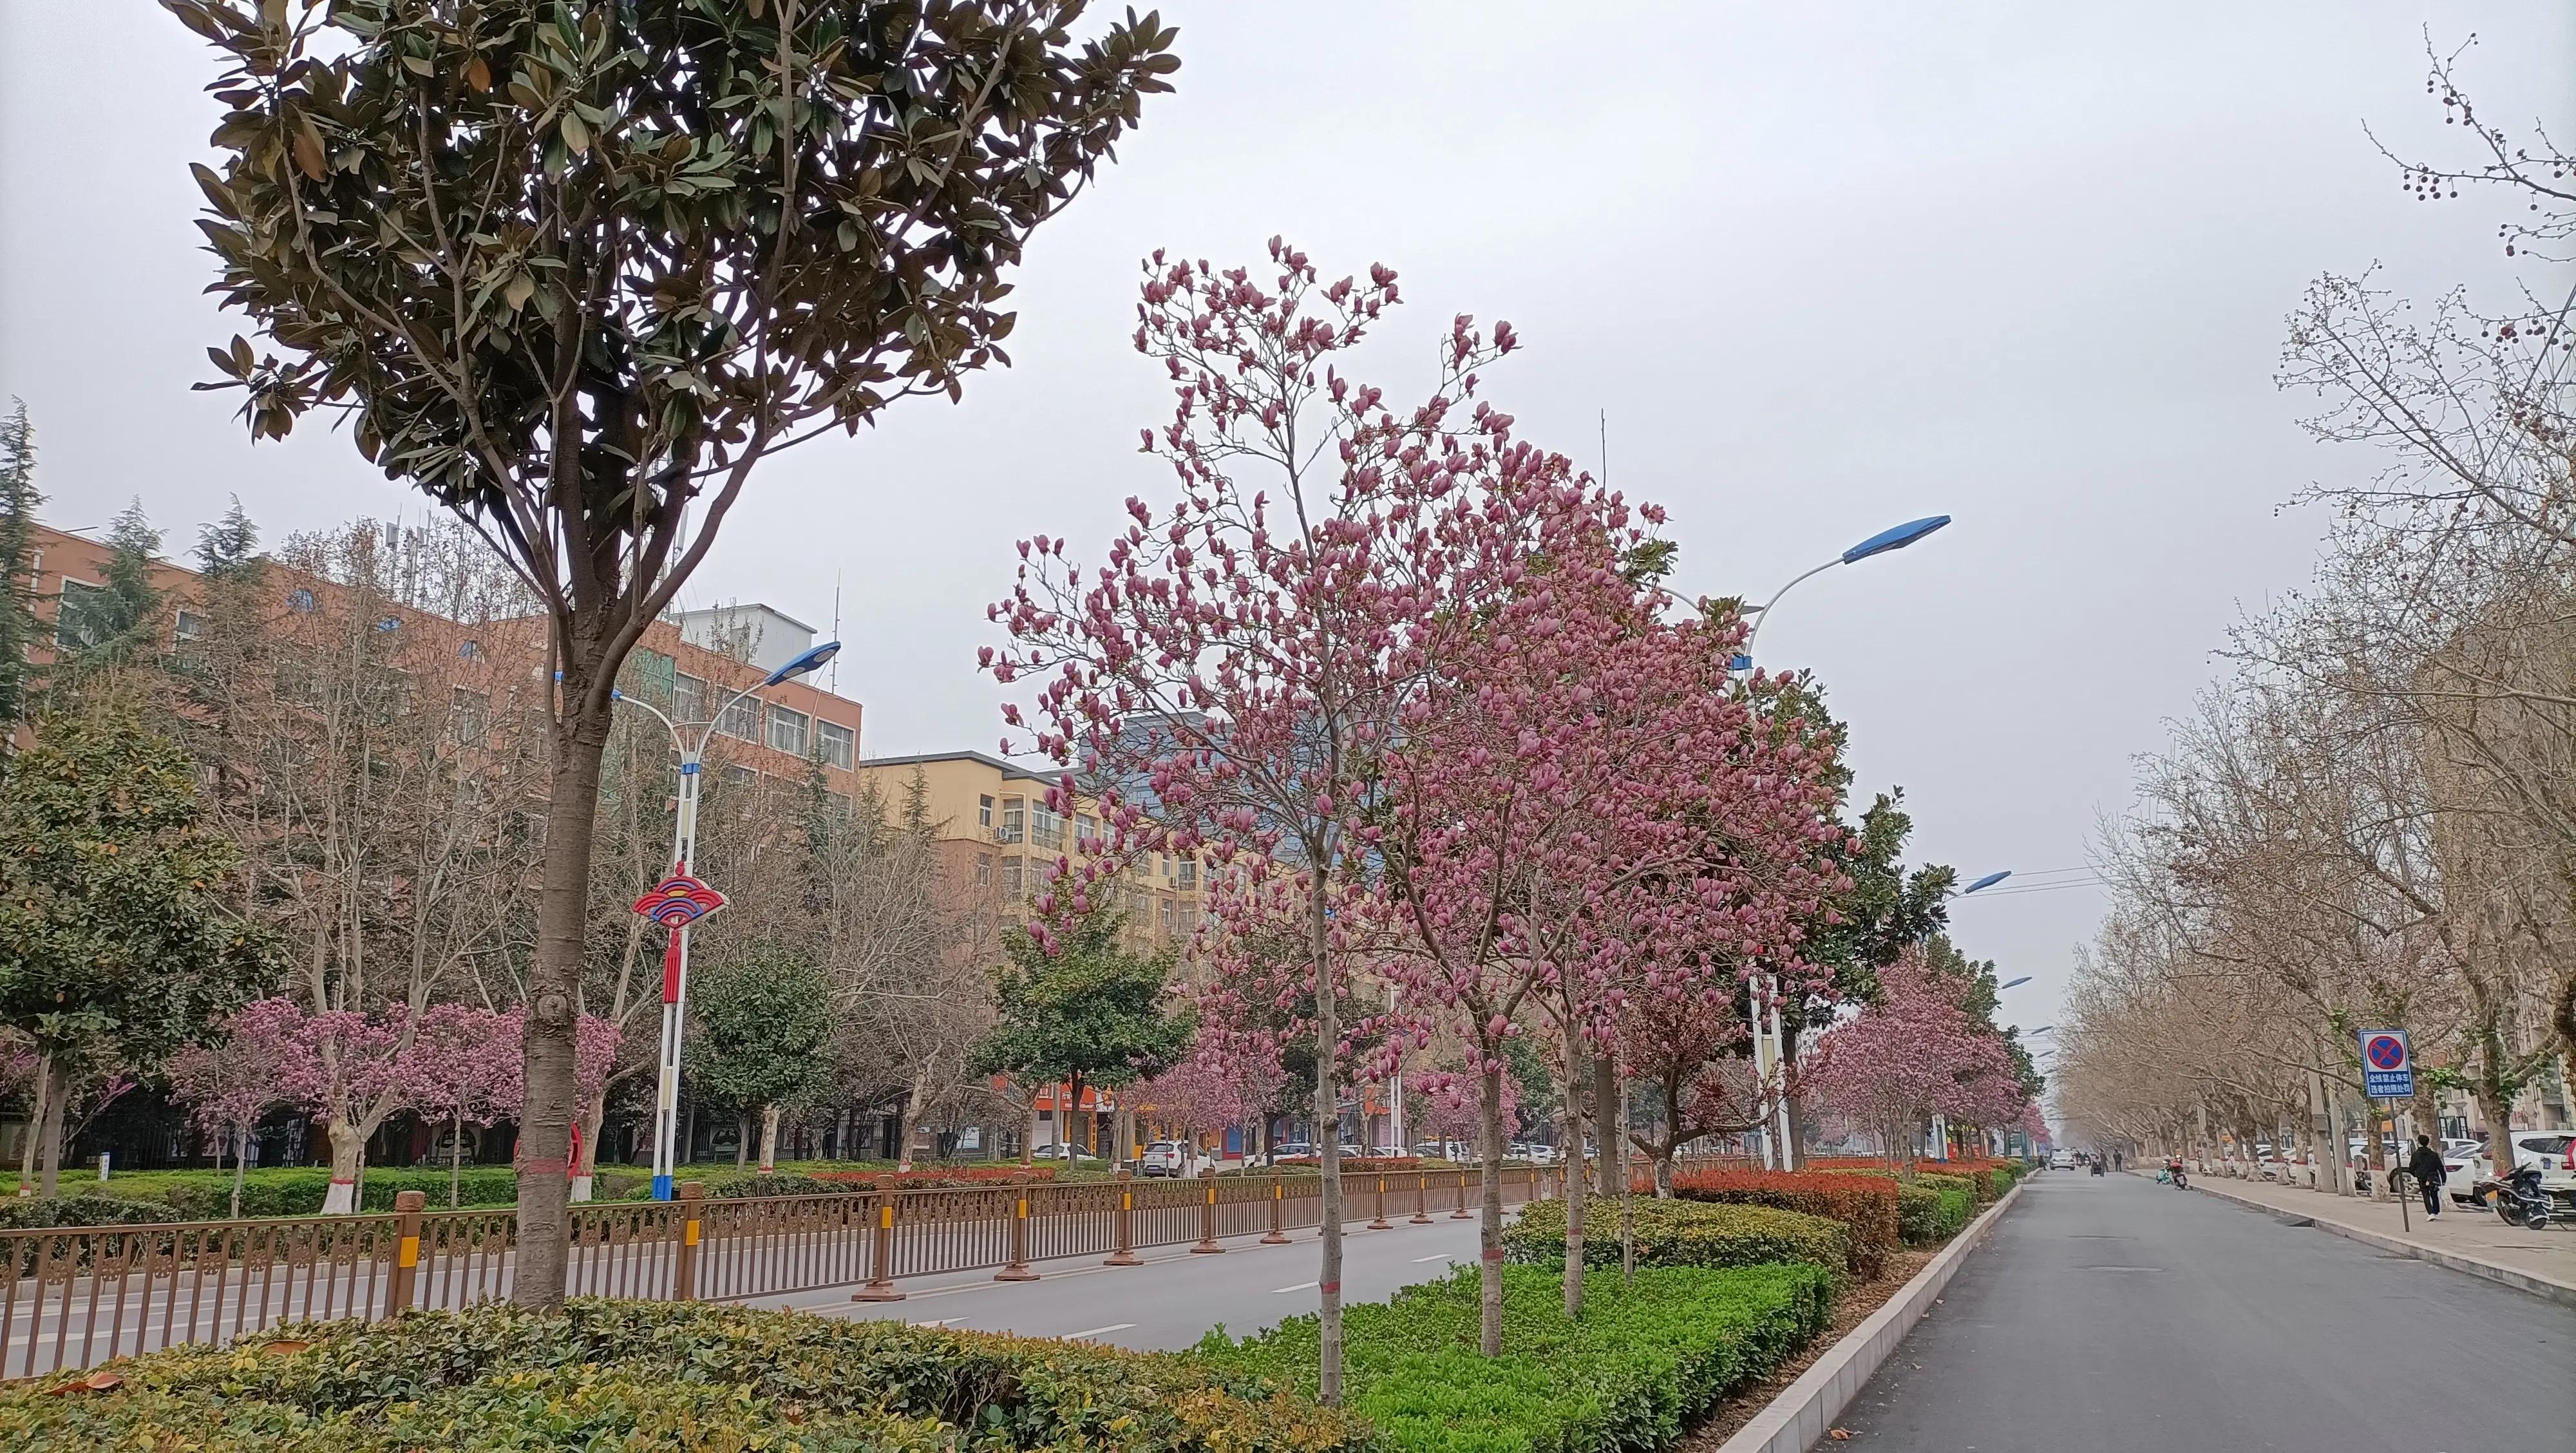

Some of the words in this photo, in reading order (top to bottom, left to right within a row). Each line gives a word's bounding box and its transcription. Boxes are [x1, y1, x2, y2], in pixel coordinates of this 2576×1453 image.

[2370, 1074, 2409, 1083] 全线禁止停车
[2371, 1084, 2410, 1094] 违者拍照处罚
